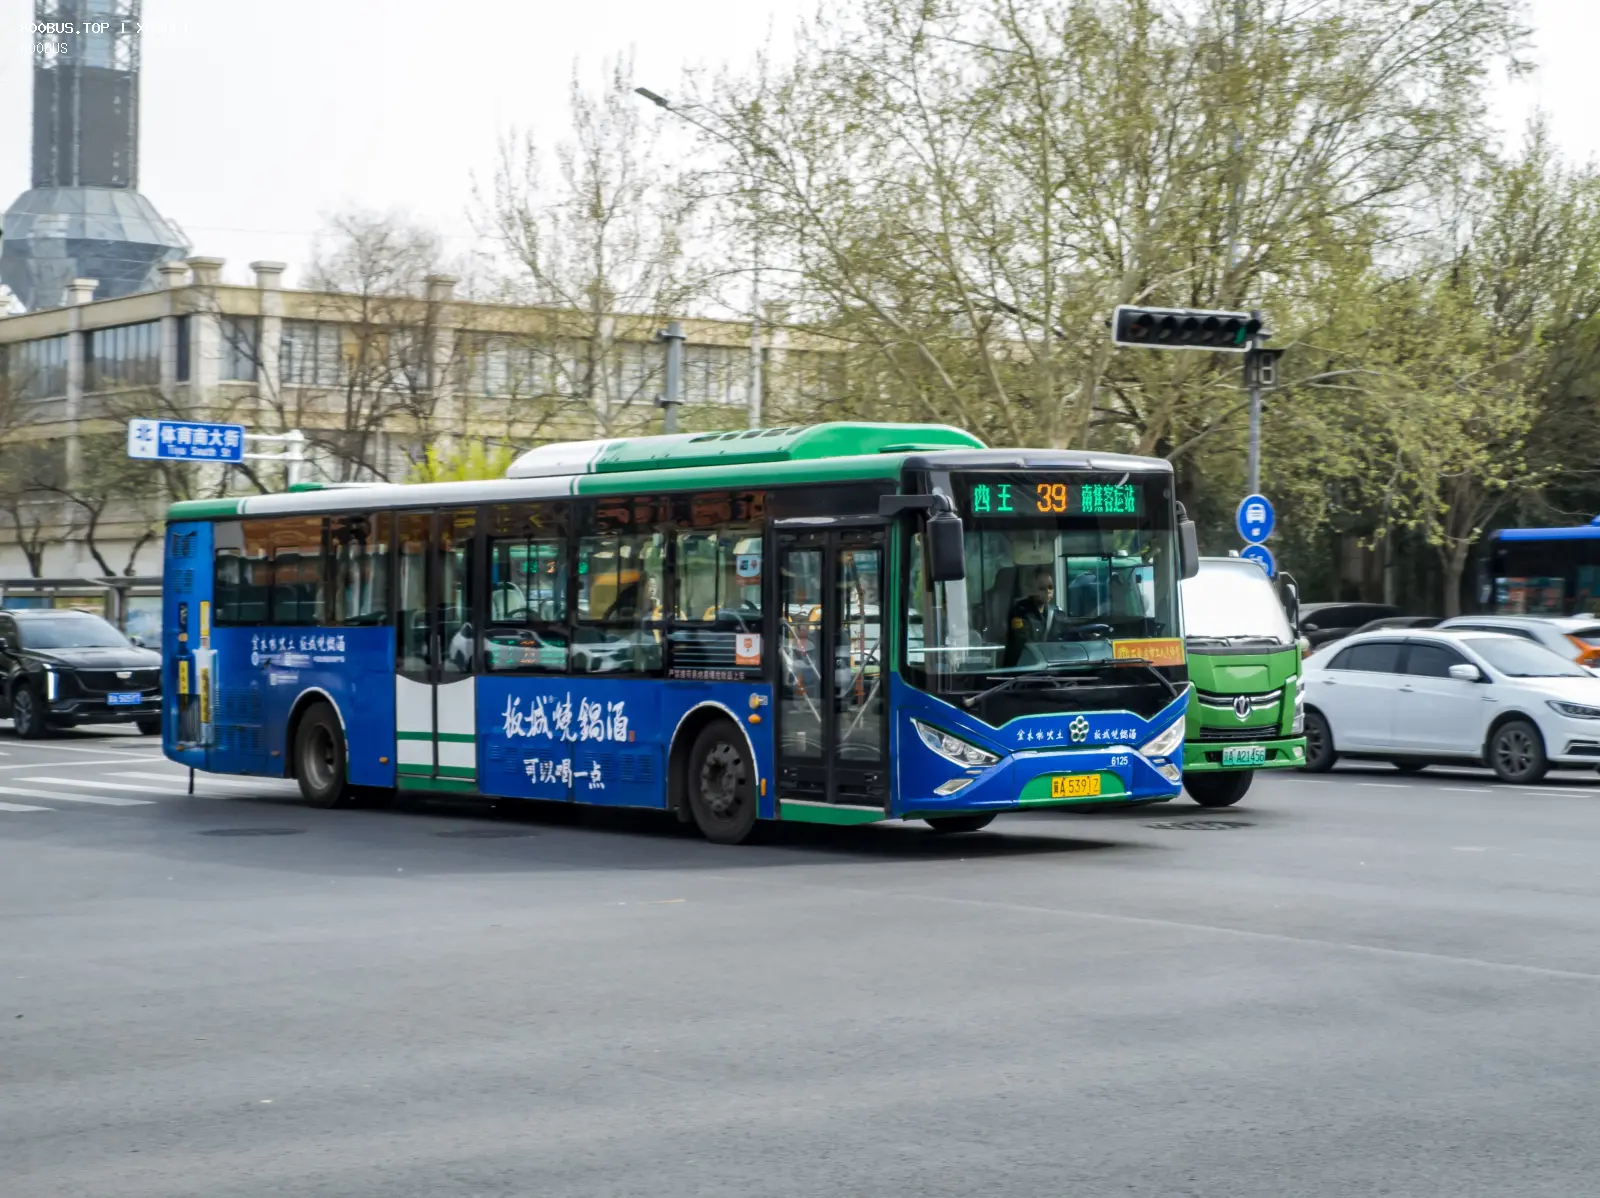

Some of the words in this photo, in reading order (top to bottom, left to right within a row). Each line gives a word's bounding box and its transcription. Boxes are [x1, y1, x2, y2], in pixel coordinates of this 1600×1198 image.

[974, 484, 1013, 512] 西王
[1036, 483, 1066, 512] 39
[523, 757, 605, 789] 可以喝一点
[1111, 755, 1128, 766] 6125
